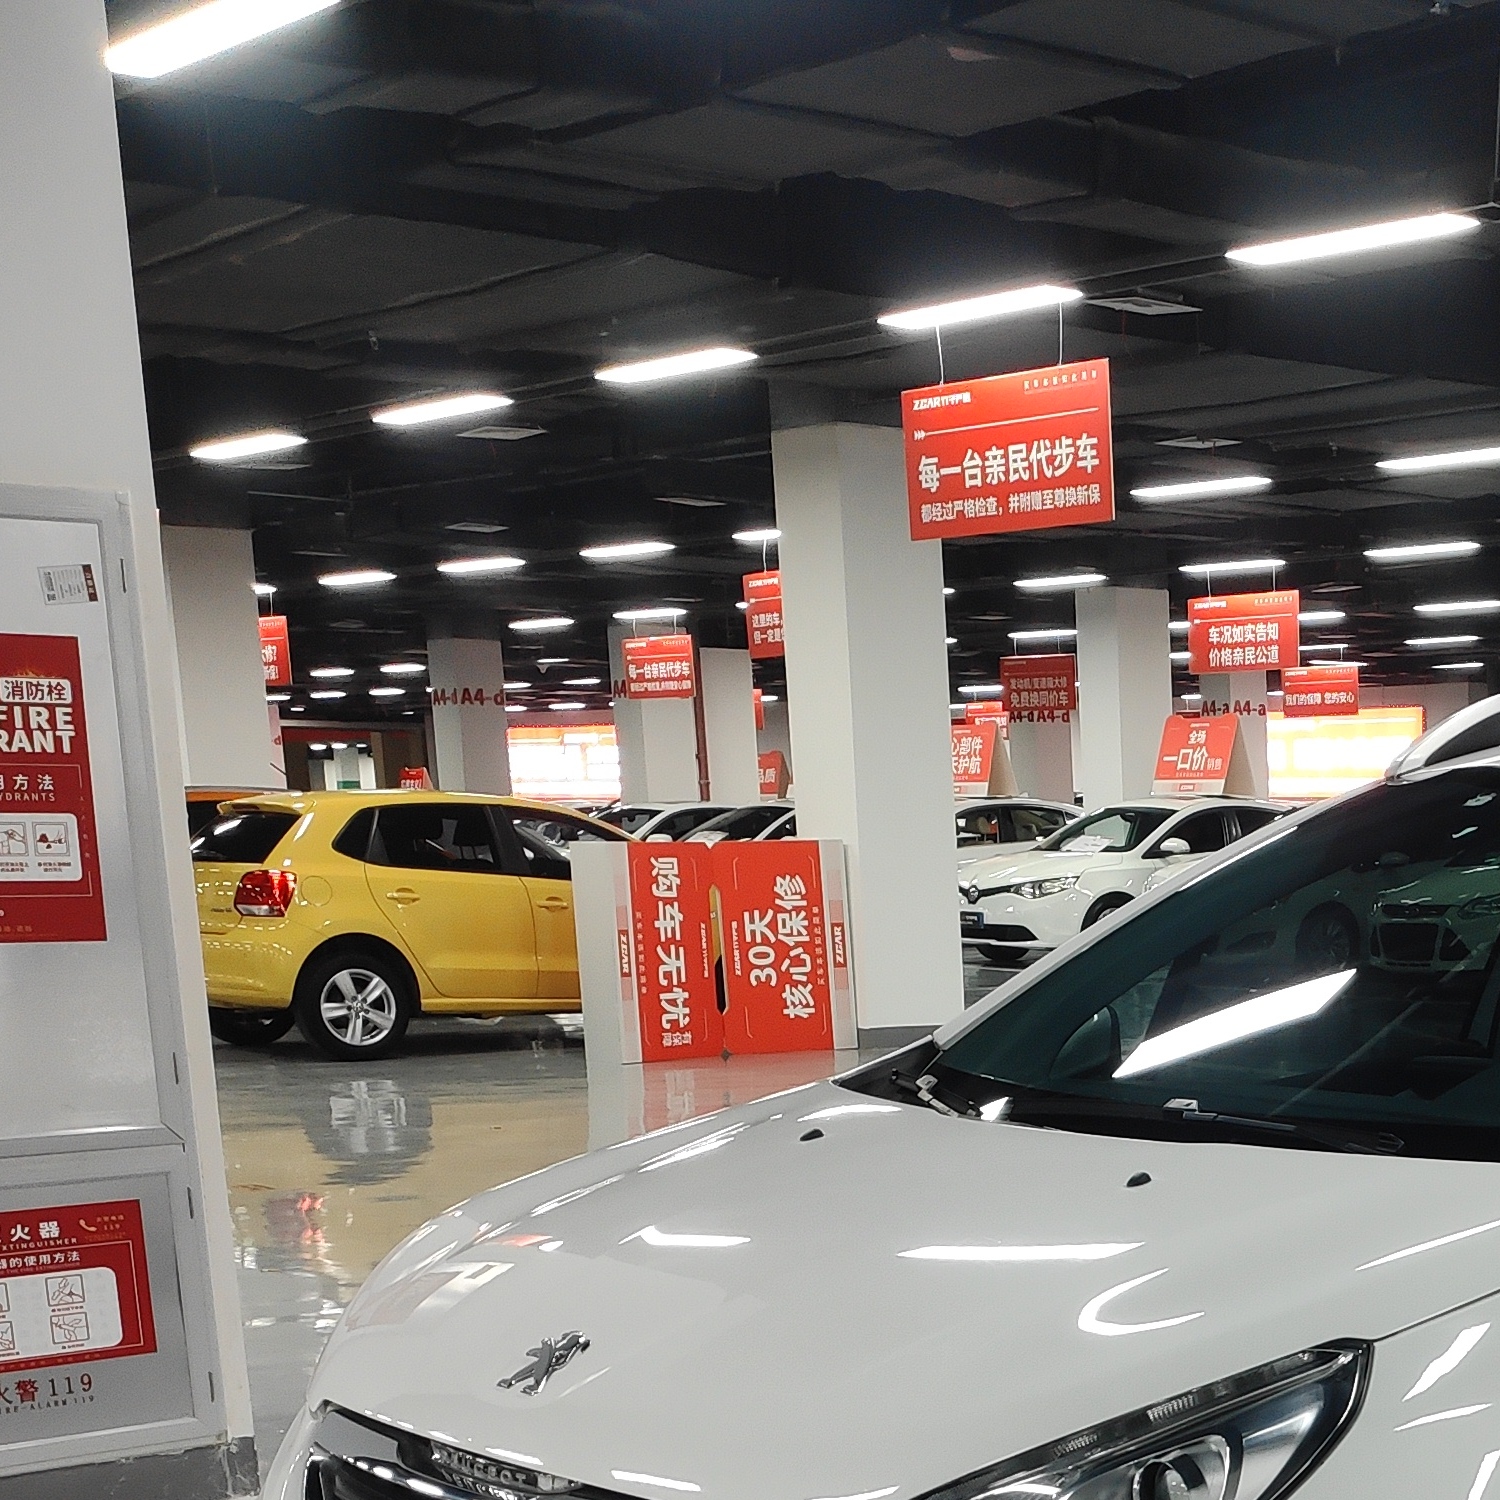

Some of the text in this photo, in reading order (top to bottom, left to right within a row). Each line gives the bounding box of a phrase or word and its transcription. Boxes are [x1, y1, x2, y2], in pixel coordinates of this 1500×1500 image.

[918, 433, 1099, 493] 每一台亲民代步车
[1209, 622, 1279, 646] 车况如实告知
[1209, 644, 1279, 667] 价格亲民公道
[4, 680, 67, 701] 消防栓
[461, 688, 505, 706] A4-d
[1010, 690, 1068, 707] 免费换同价车
[1201, 700, 1230, 716] A4-a
[1233, 700, 1267, 716] A4-a
[1188, 730, 1207, 744] 全场
[1163, 746, 1208, 770] 一口价
[619, 933, 629, 974] ZCAR
[650, 857, 691, 1030] 购车无忧
[743, 908, 777, 987] 30天
[774, 874, 816, 1019] 核心保修
[833, 926, 845, 964] ZCAR
[49, 1373, 92, 1397] 119
